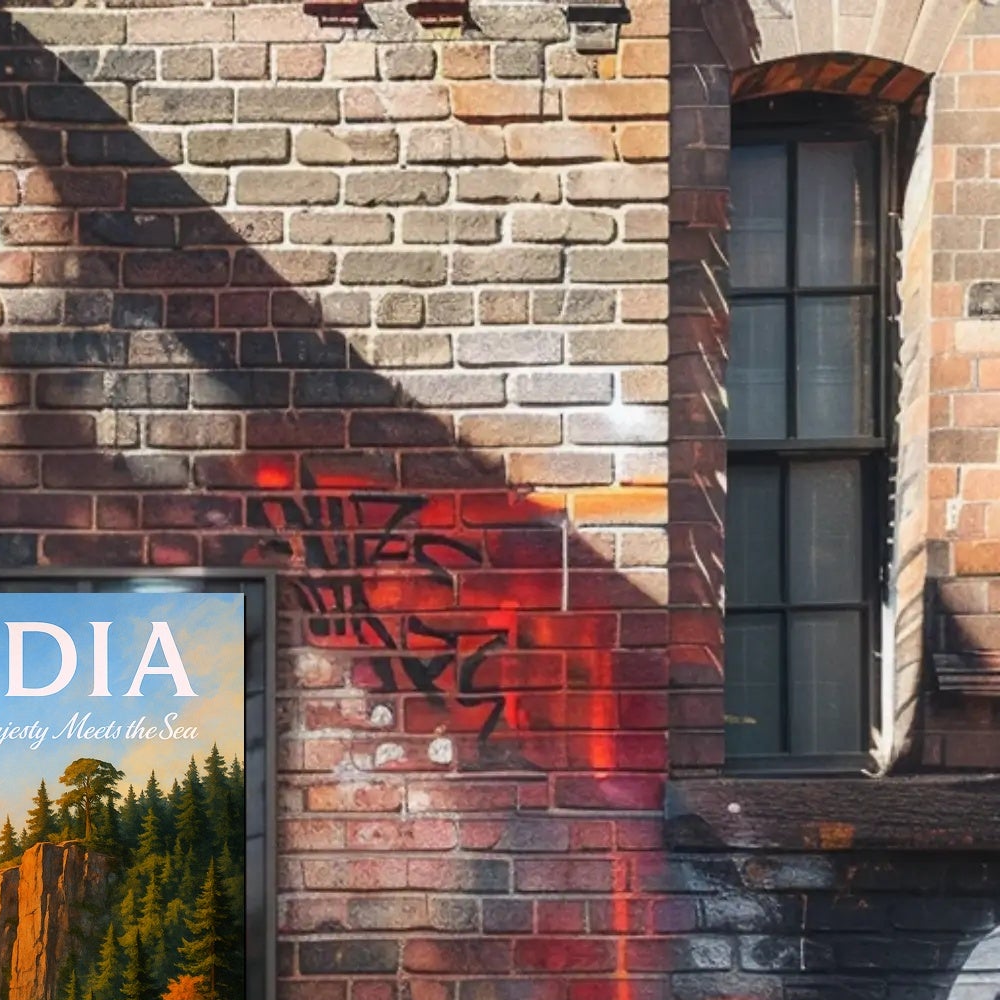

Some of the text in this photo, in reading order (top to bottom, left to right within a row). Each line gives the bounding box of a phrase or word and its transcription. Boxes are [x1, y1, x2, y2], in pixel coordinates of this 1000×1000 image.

[51, 712, 123, 740] Meets
[125, 715, 158, 740] the
[158, 712, 199, 740] Sea
